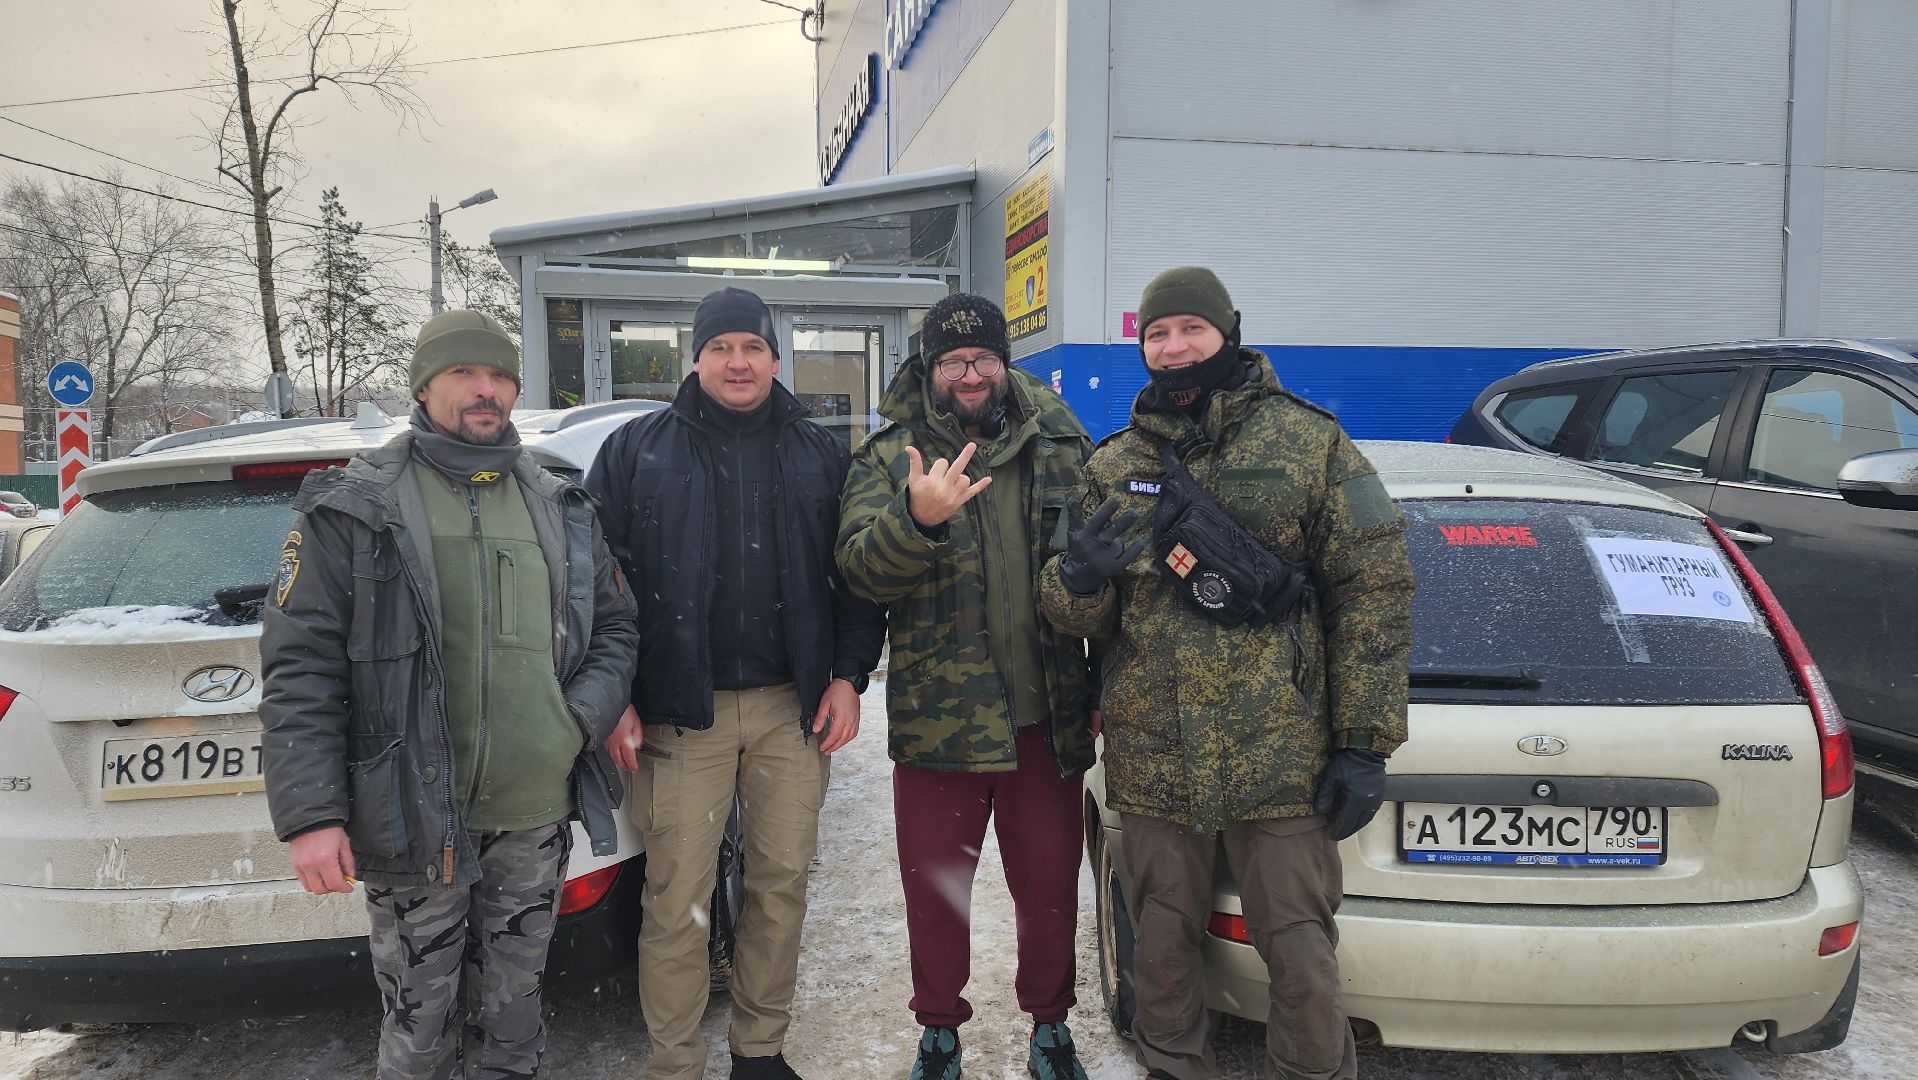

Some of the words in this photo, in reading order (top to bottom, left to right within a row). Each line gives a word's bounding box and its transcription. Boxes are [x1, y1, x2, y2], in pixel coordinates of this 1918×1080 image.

[1037, 265, 1044, 297] 2
[1606, 553, 1723, 579] ГУМАНИТАРНЫЙ
[1660, 575, 1695, 597] ГРУЗ
[1722, 744, 1793, 761] KALINA
[1416, 806, 1581, 847] А123МС
[1590, 806, 1652, 836] 790
[1605, 838, 1636, 848] RUS
[1587, 857, 1641, 865] www.a-vek.ru
